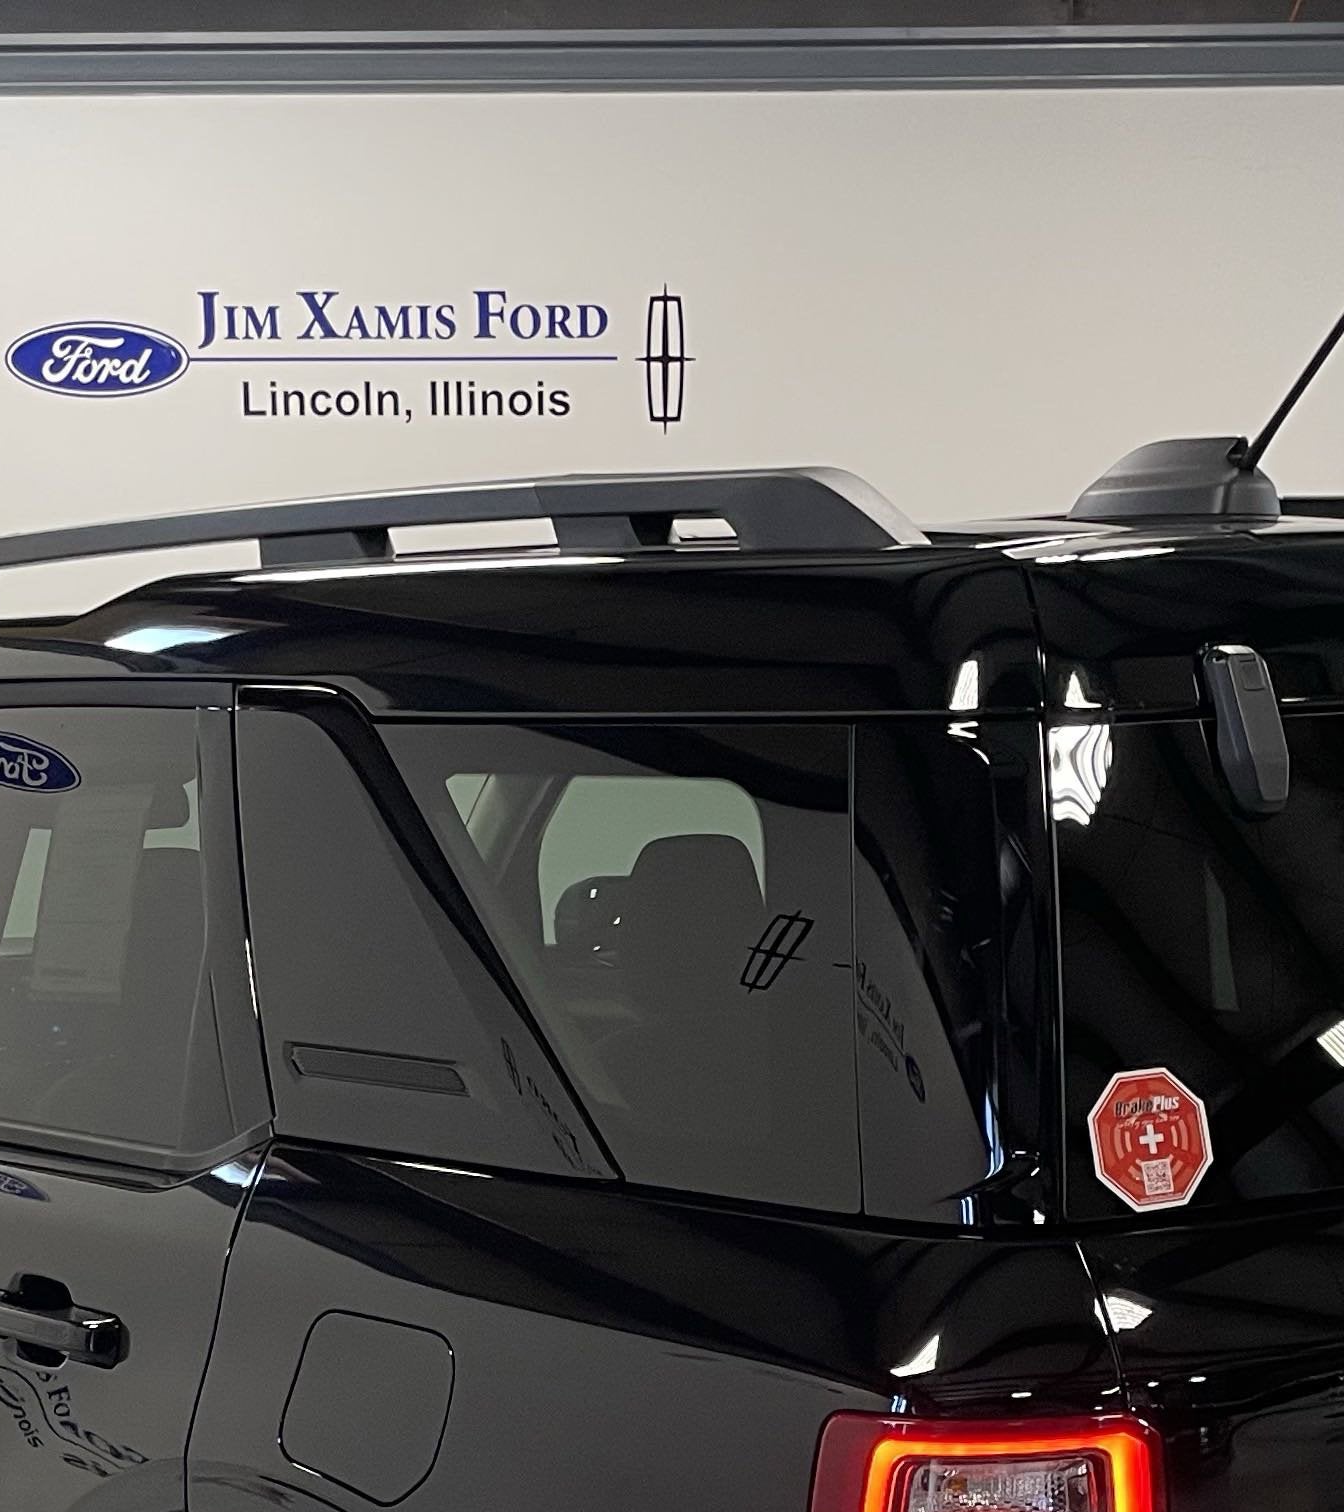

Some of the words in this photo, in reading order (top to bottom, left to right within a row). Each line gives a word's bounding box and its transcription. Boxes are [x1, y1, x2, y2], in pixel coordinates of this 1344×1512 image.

[196, 291, 279, 349] JIM
[296, 291, 456, 340] XAMIS
[472, 291, 609, 340] FORD
[40, 335, 155, 385] Ford
[241, 381, 413, 422] Lincoln,
[429, 381, 571, 417] Illinois
